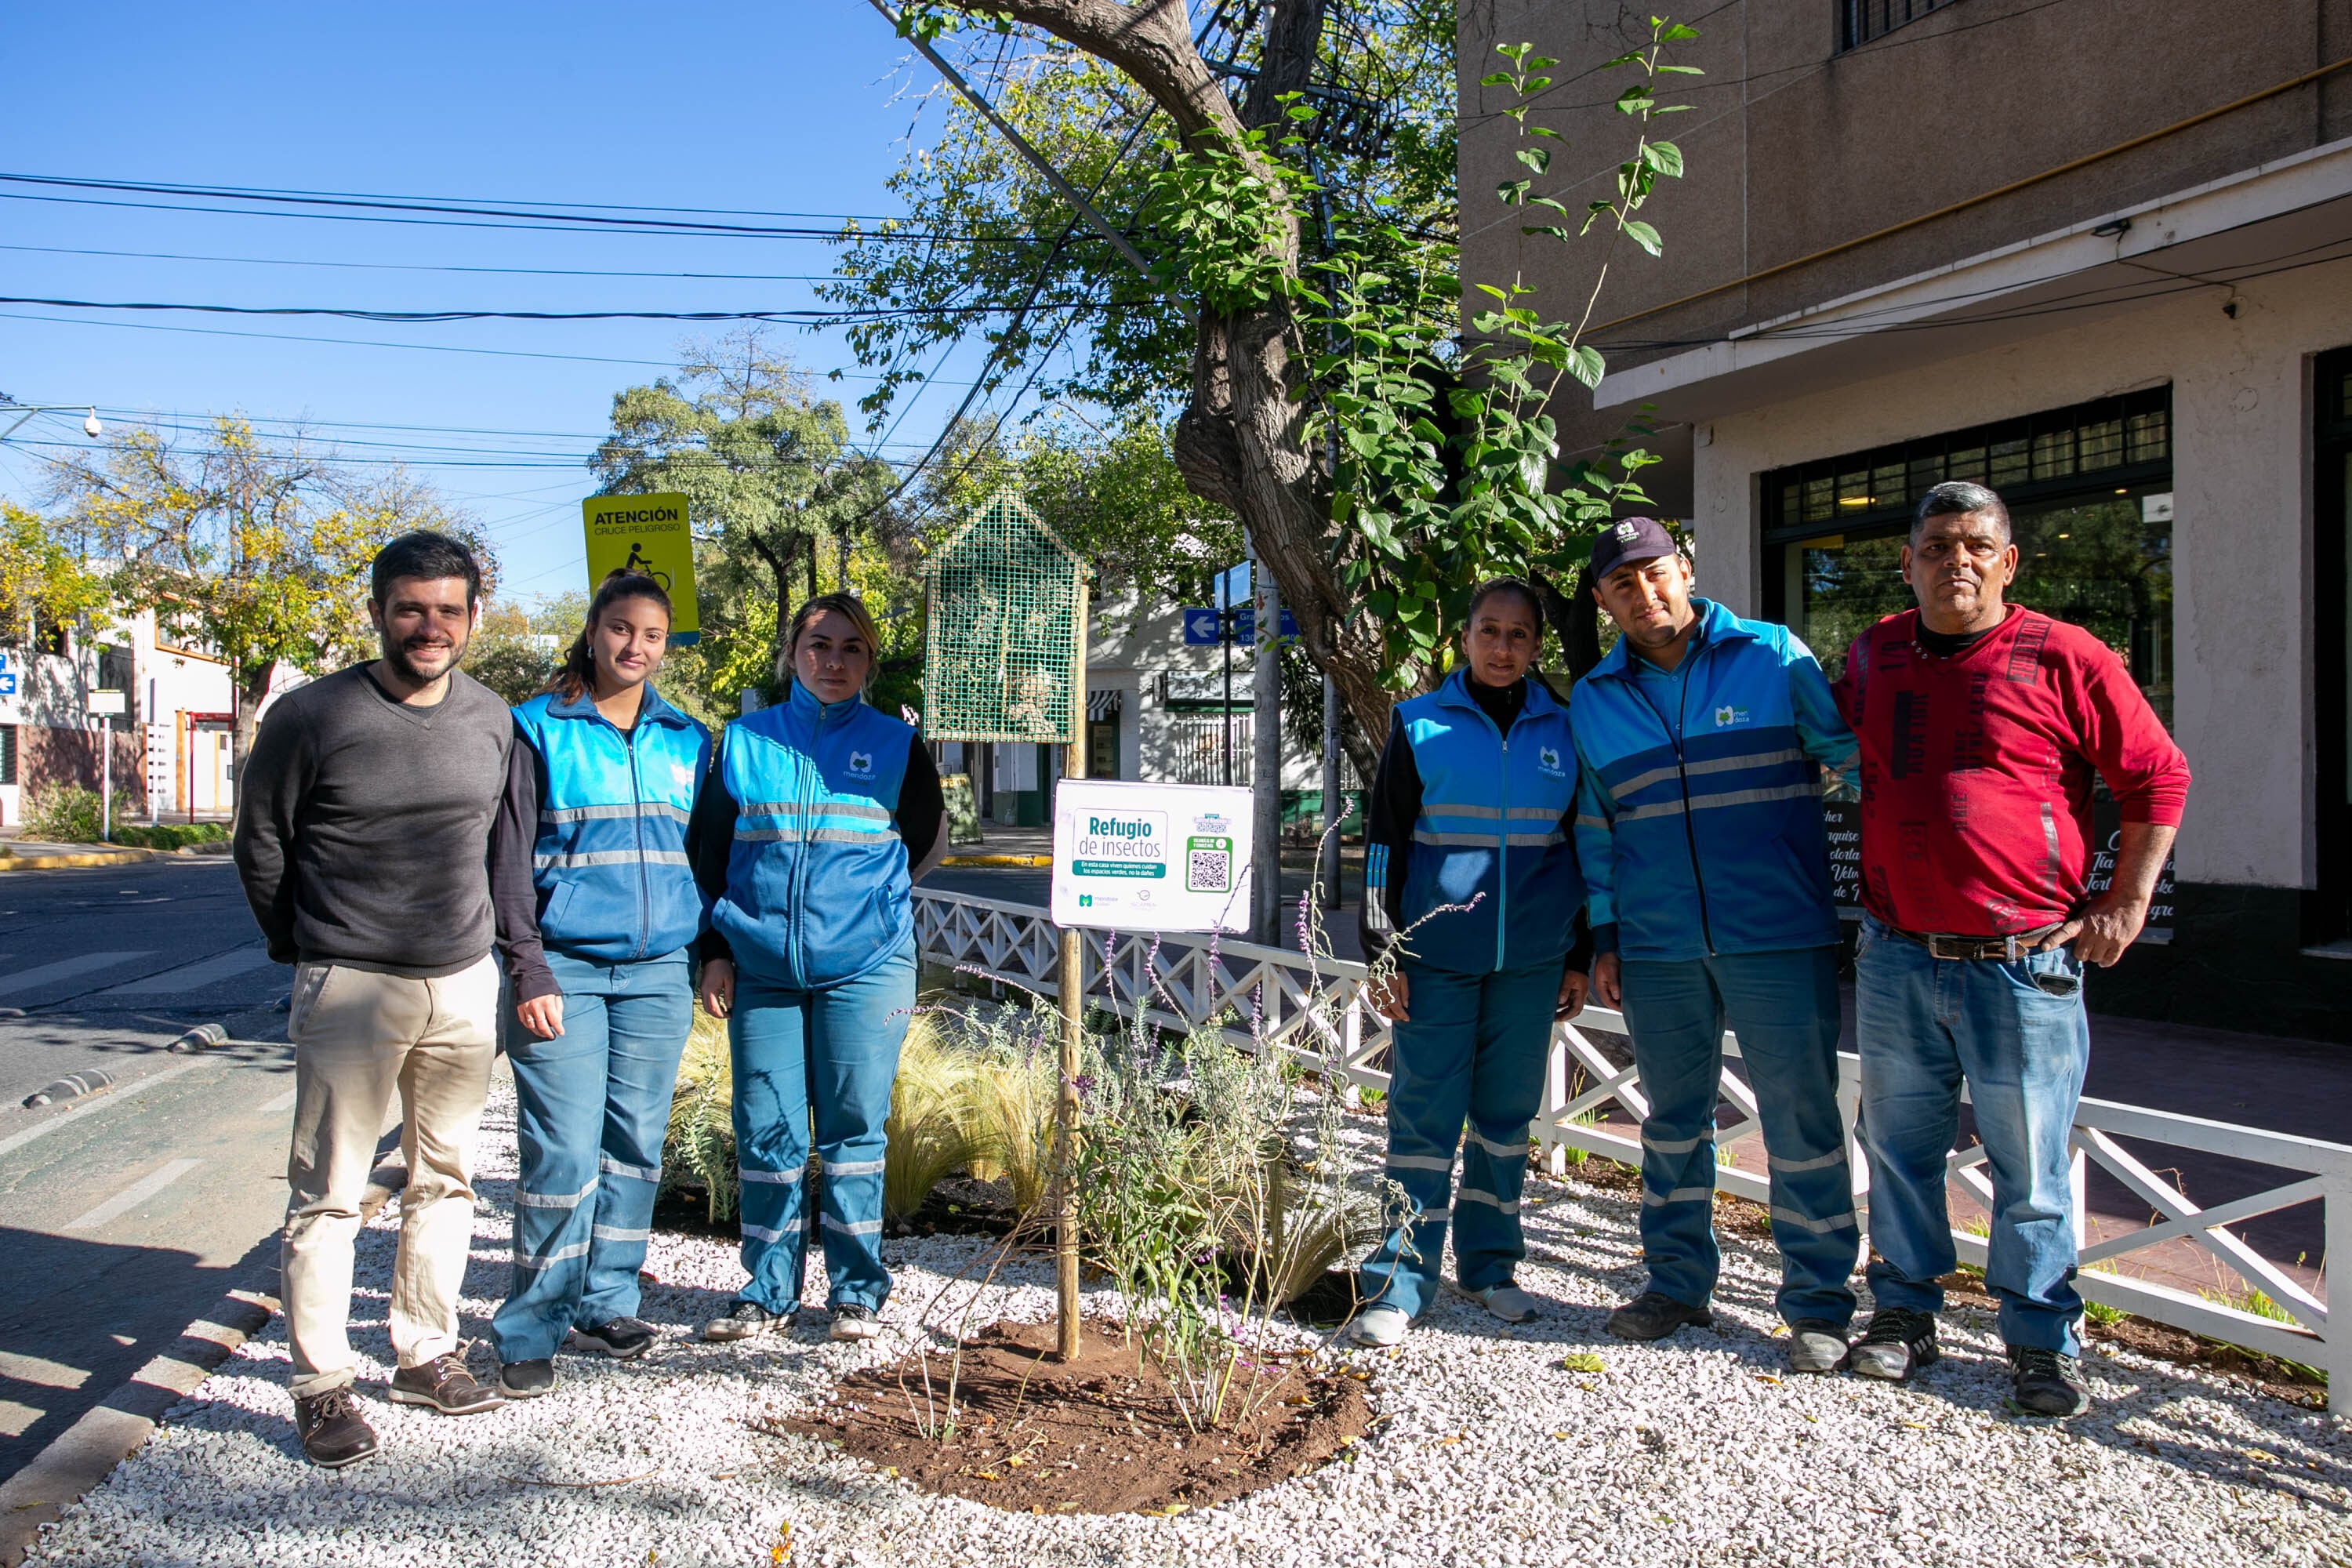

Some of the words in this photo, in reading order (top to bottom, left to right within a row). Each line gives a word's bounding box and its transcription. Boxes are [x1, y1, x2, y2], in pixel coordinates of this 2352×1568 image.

[594, 506, 678, 525] ATENCIÓN
[594, 526, 626, 536] CRUCE
[629, 523, 680, 534] PELIGROSO
[1823, 810, 1844, 823] her
[1089, 817, 1152, 840] Refugio
[1827, 830, 1860, 845] rquise
[1079, 837, 1098, 855] de
[1102, 837, 1160, 858] insectos
[1830, 848, 1861, 860] otorta
[2086, 873, 2113, 892] Tort
[1833, 885, 1847, 898] de
